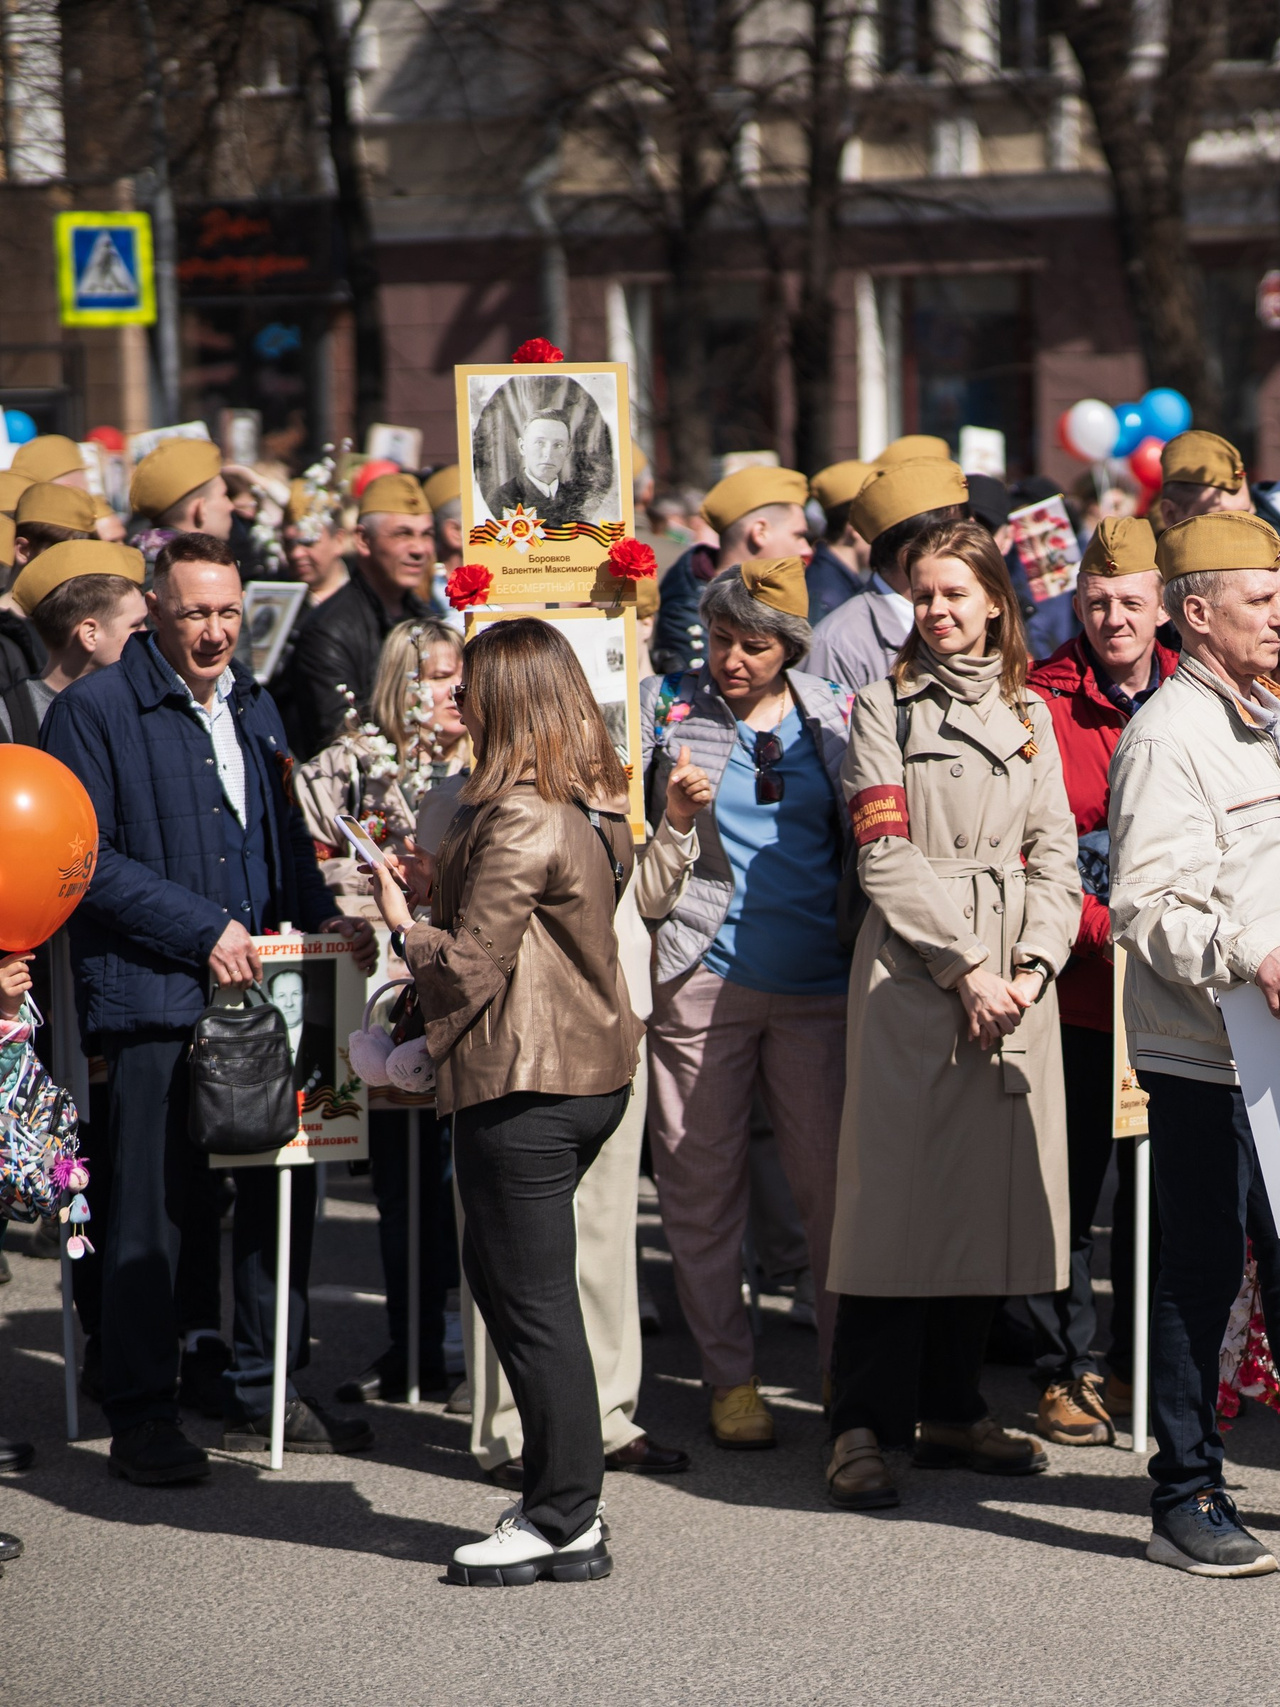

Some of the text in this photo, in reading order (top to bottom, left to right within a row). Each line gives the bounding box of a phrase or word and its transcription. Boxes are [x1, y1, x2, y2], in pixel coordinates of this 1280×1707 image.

[528, 554, 571, 565] Боровков
[501, 564, 600, 575] Валентин Максимович
[496, 580, 606, 595] БЕССМЕРТНЫЙ ПОЛК
[82, 850, 93, 879] 9
[256, 940, 355, 956] МЕРТНЫЙ ПОЛ
